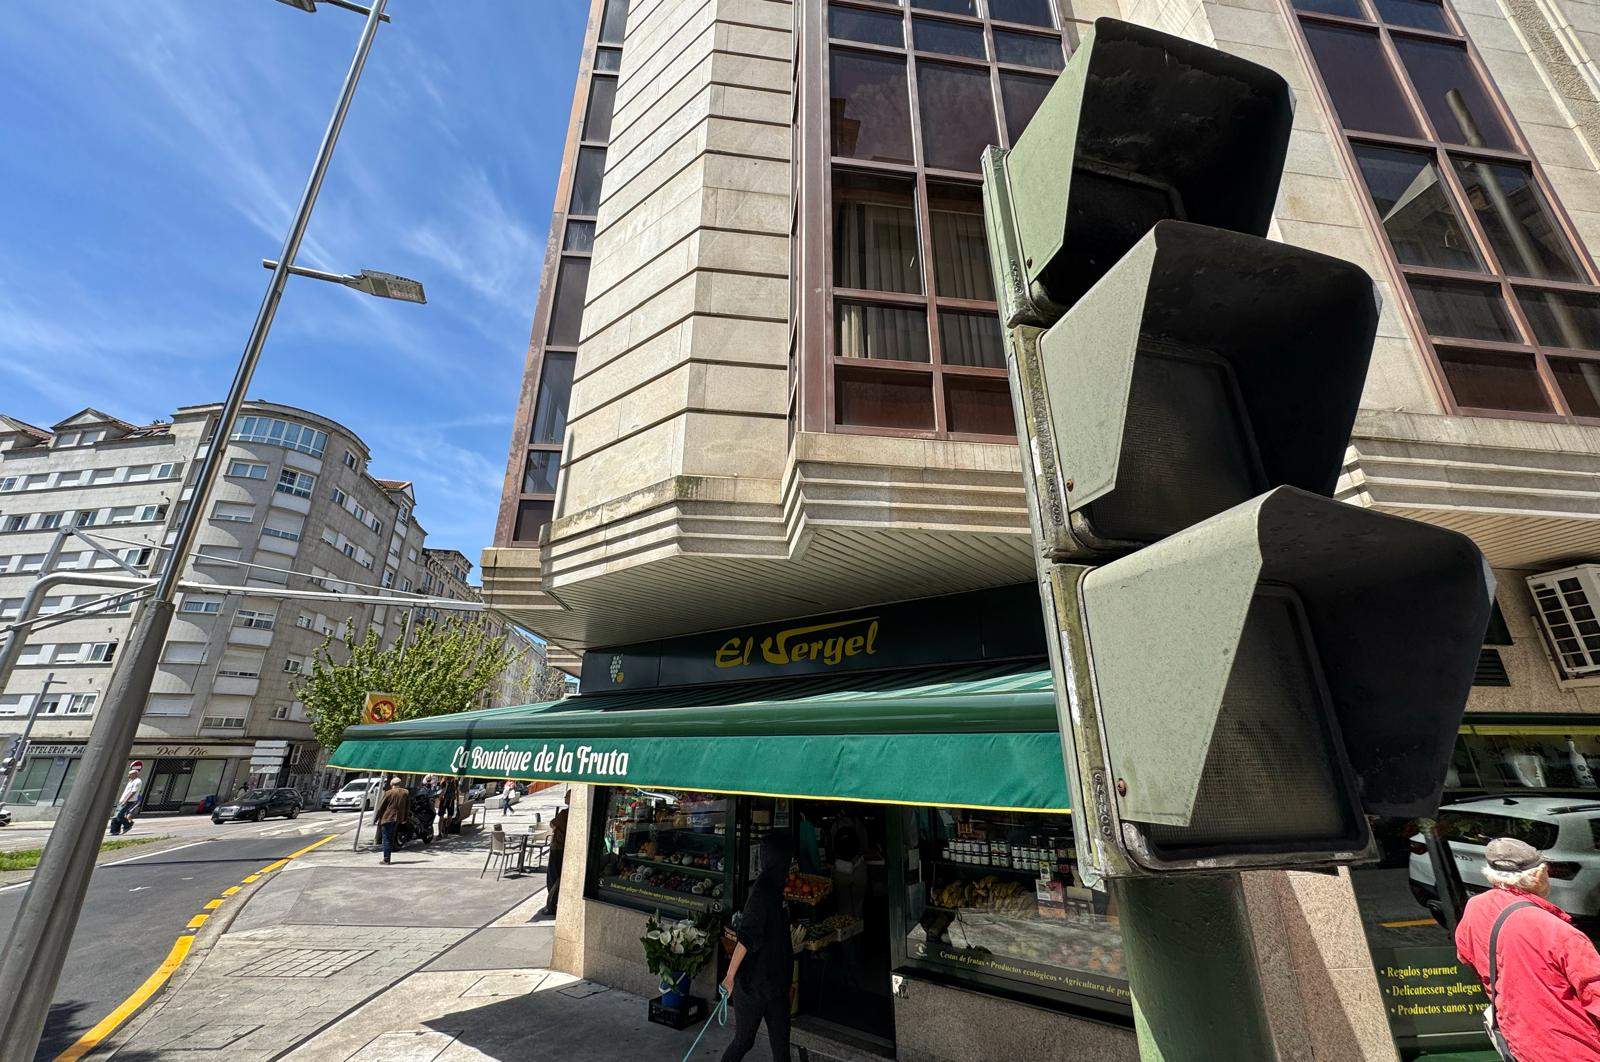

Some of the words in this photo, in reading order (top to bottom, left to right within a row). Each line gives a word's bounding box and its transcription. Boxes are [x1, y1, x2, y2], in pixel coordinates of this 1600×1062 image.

[714, 637, 752, 668] El
[760, 616, 880, 666] Vergel
[450, 745, 471, 773] La
[471, 745, 532, 776] Boutique
[533, 744, 553, 773] de
[555, 744, 574, 774] la
[577, 744, 630, 776] Fruta
[991, 960, 1022, 974] Productos
[1023, 969, 1057, 982] ecológicos
[1063, 976, 1105, 991] Agricultura
[1106, 985, 1115, 994] de
[1116, 988, 1131, 997] pro
[1387, 965, 1421, 980] Regalos
[1422, 966, 1458, 979] gourmet
[1392, 985, 1445, 996] Delicatessen
[1447, 982, 1481, 996] gallegas
[1398, 1003, 1441, 1016] Productos
[1442, 1004, 1467, 1014] sanos
[1468, 1004, 1474, 1015] y
